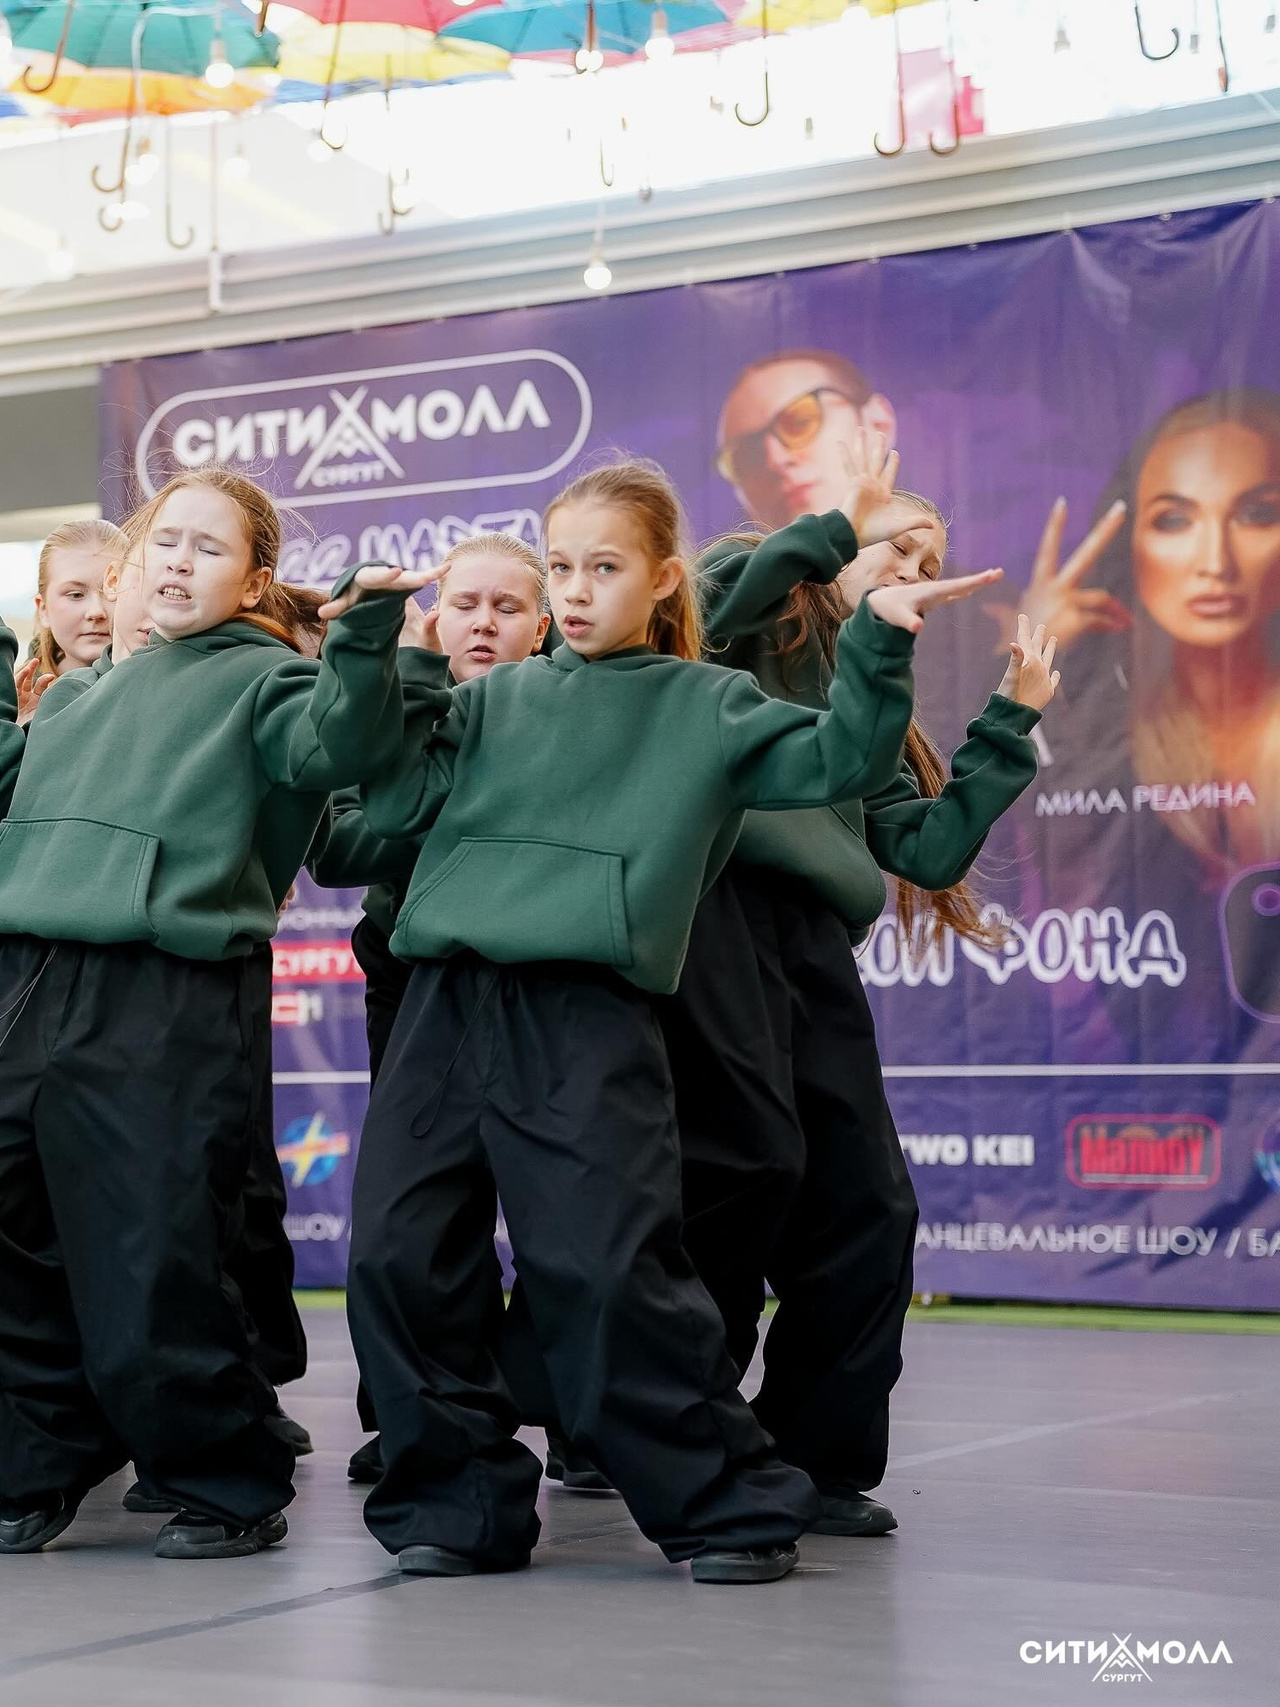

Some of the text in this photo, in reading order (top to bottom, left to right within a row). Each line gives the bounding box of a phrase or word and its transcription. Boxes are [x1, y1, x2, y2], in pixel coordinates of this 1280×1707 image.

[173, 379, 552, 468] СИТИ МОЛЛ
[1035, 781, 1257, 818] МИЛА РЕДИНА
[916, 1221, 1132, 1255] АНЦЕВАЛЬНОЕ
[1136, 1224, 1219, 1257] ШОУ
